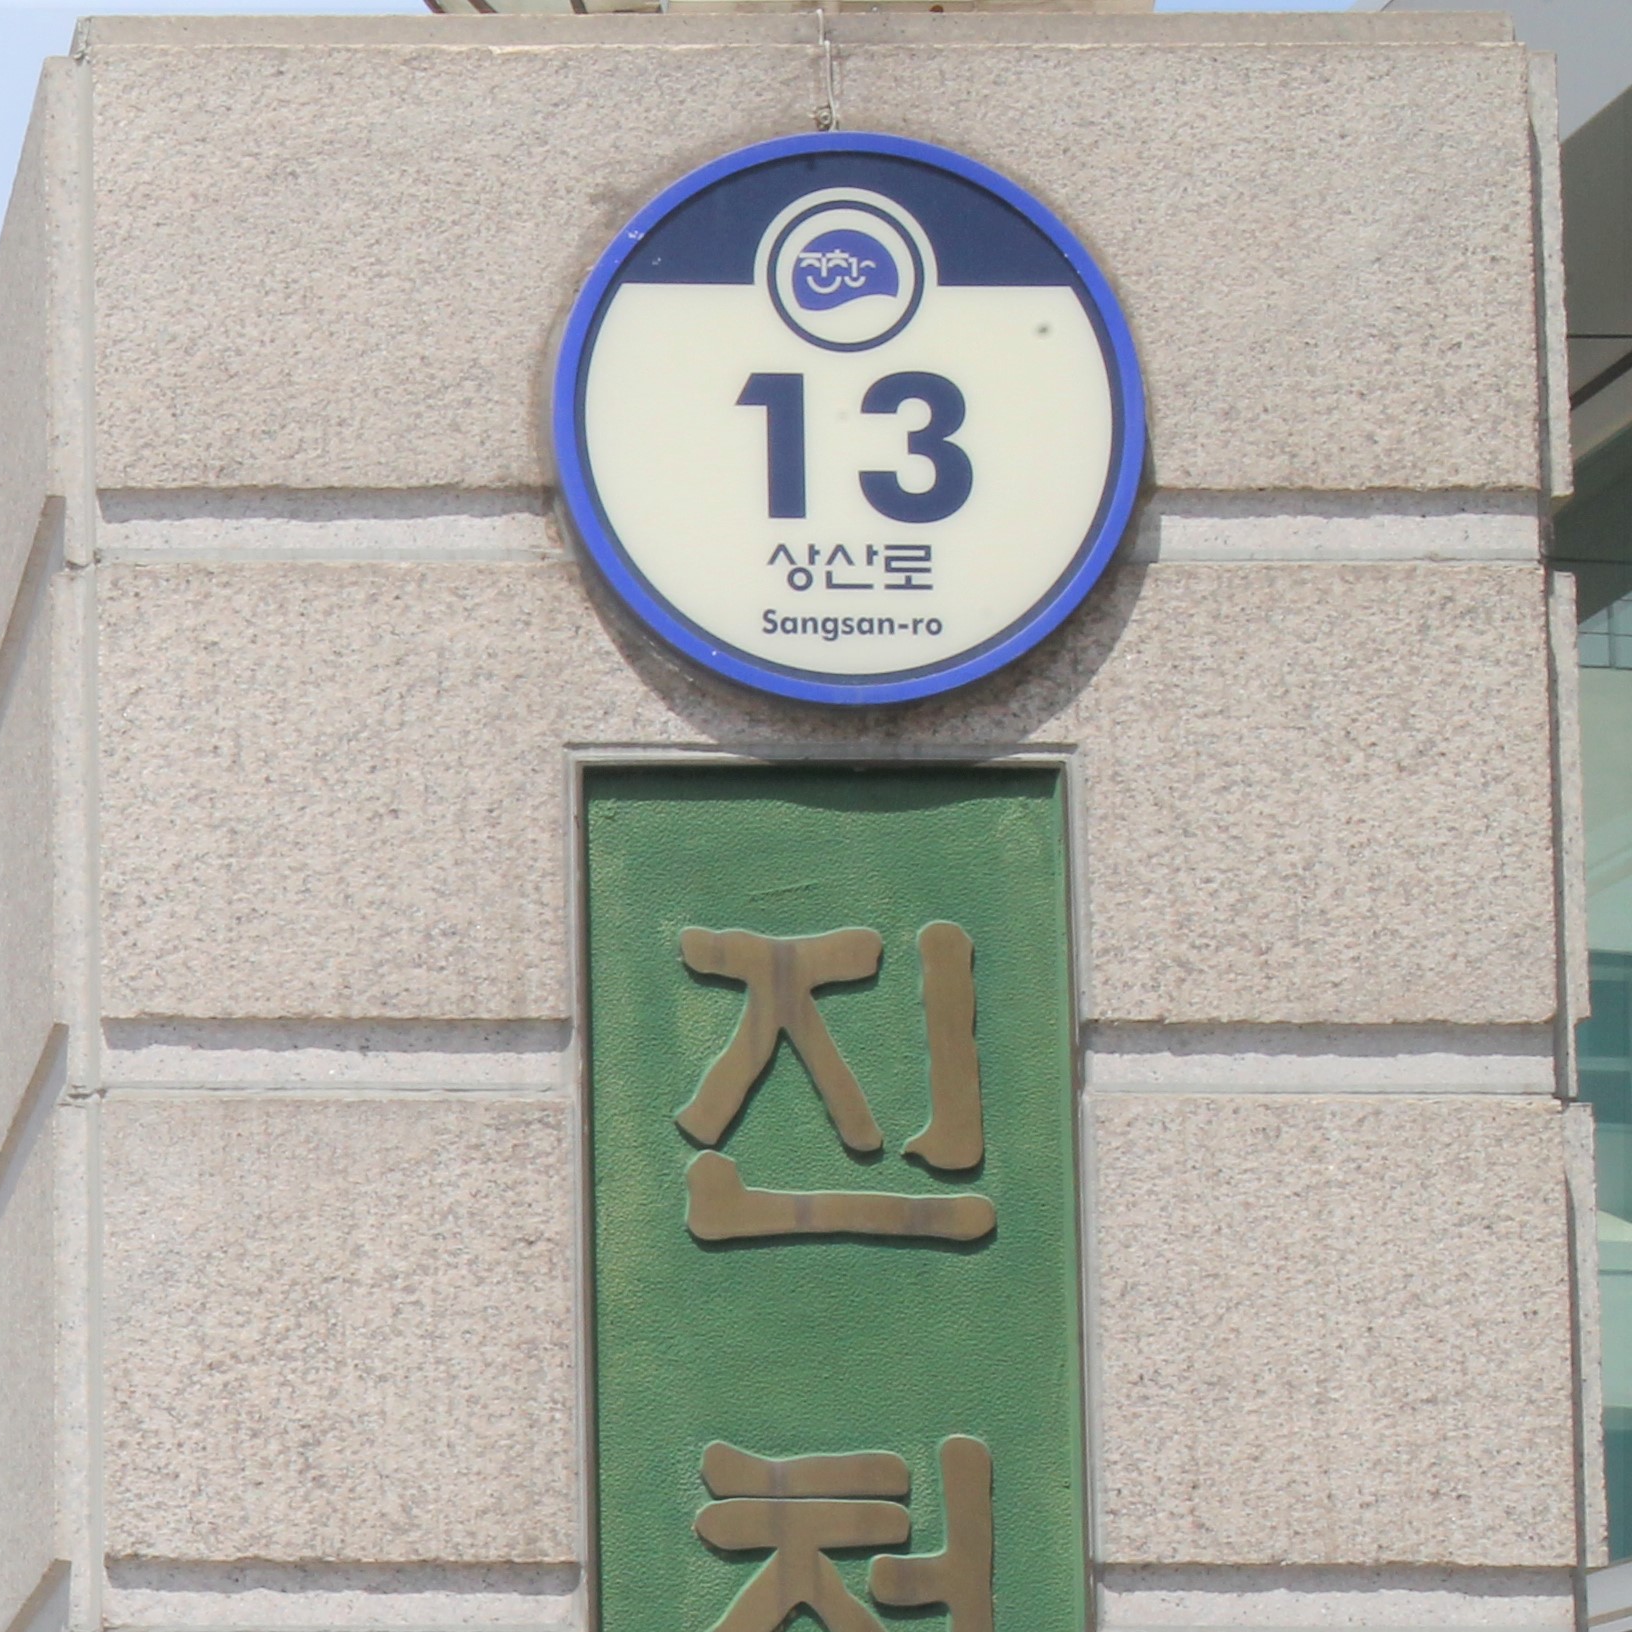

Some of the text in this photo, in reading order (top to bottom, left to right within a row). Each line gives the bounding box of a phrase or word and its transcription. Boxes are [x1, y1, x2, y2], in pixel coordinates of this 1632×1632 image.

[735, 371, 973, 524] 13
[766, 544, 933, 590] 상산로
[761, 609, 942, 640] Sangsan-ro
